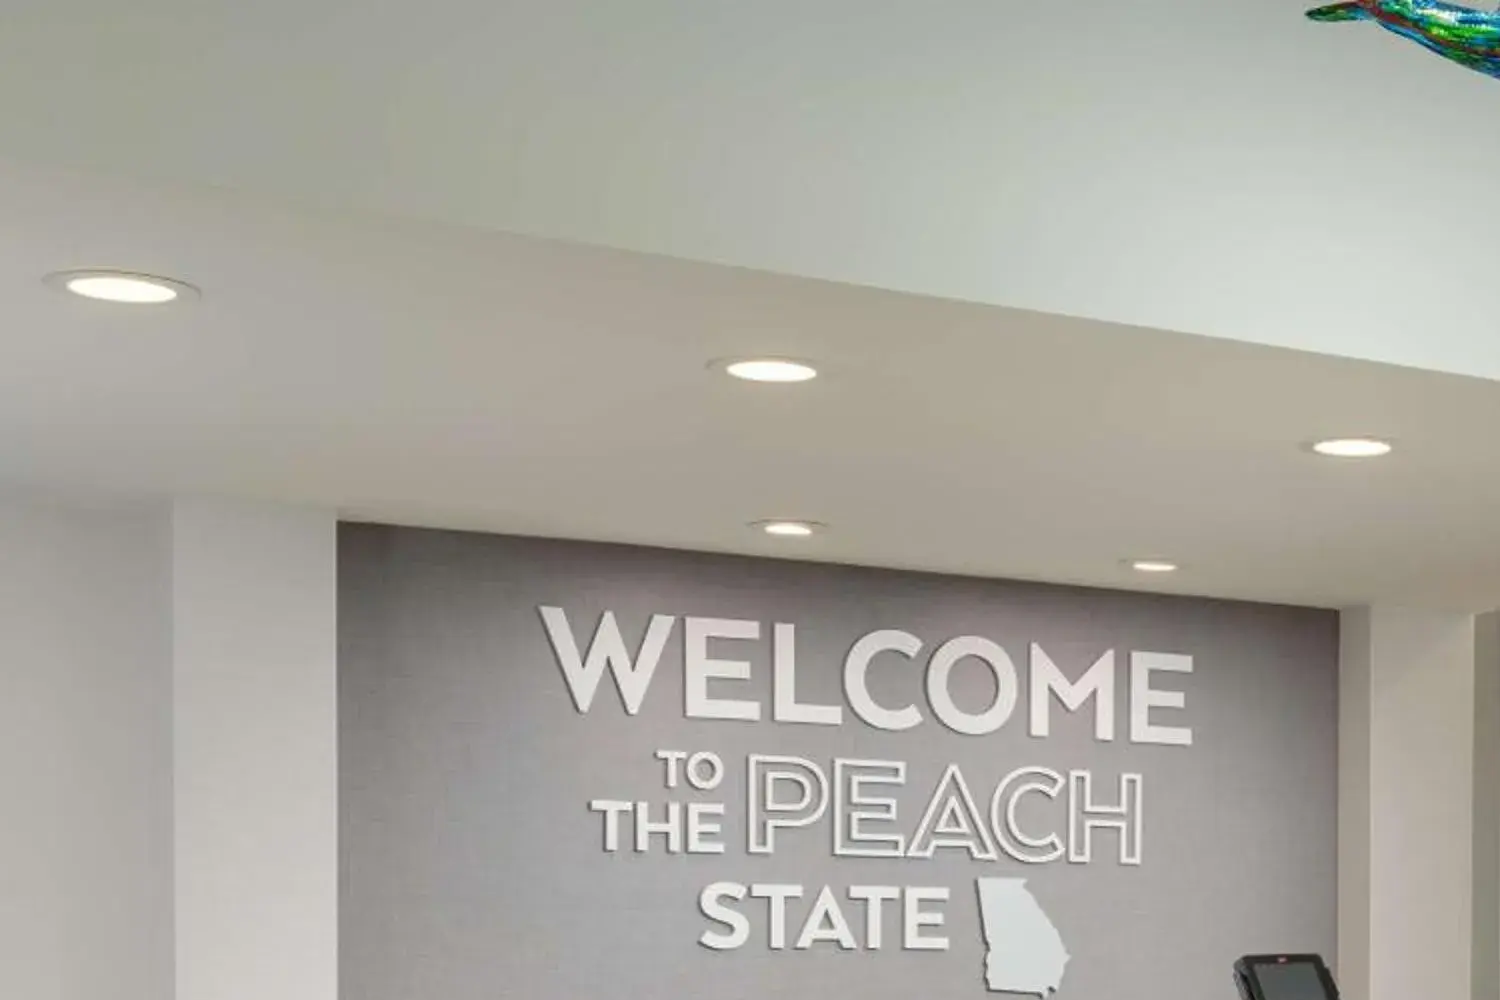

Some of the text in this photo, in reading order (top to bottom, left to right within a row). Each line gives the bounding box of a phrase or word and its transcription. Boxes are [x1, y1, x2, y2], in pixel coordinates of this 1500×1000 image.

[539, 605, 1194, 745] WELCOME
[588, 753, 1143, 866] THE PEACH
[656, 750, 725, 790] TO
[698, 882, 951, 951] STATE
